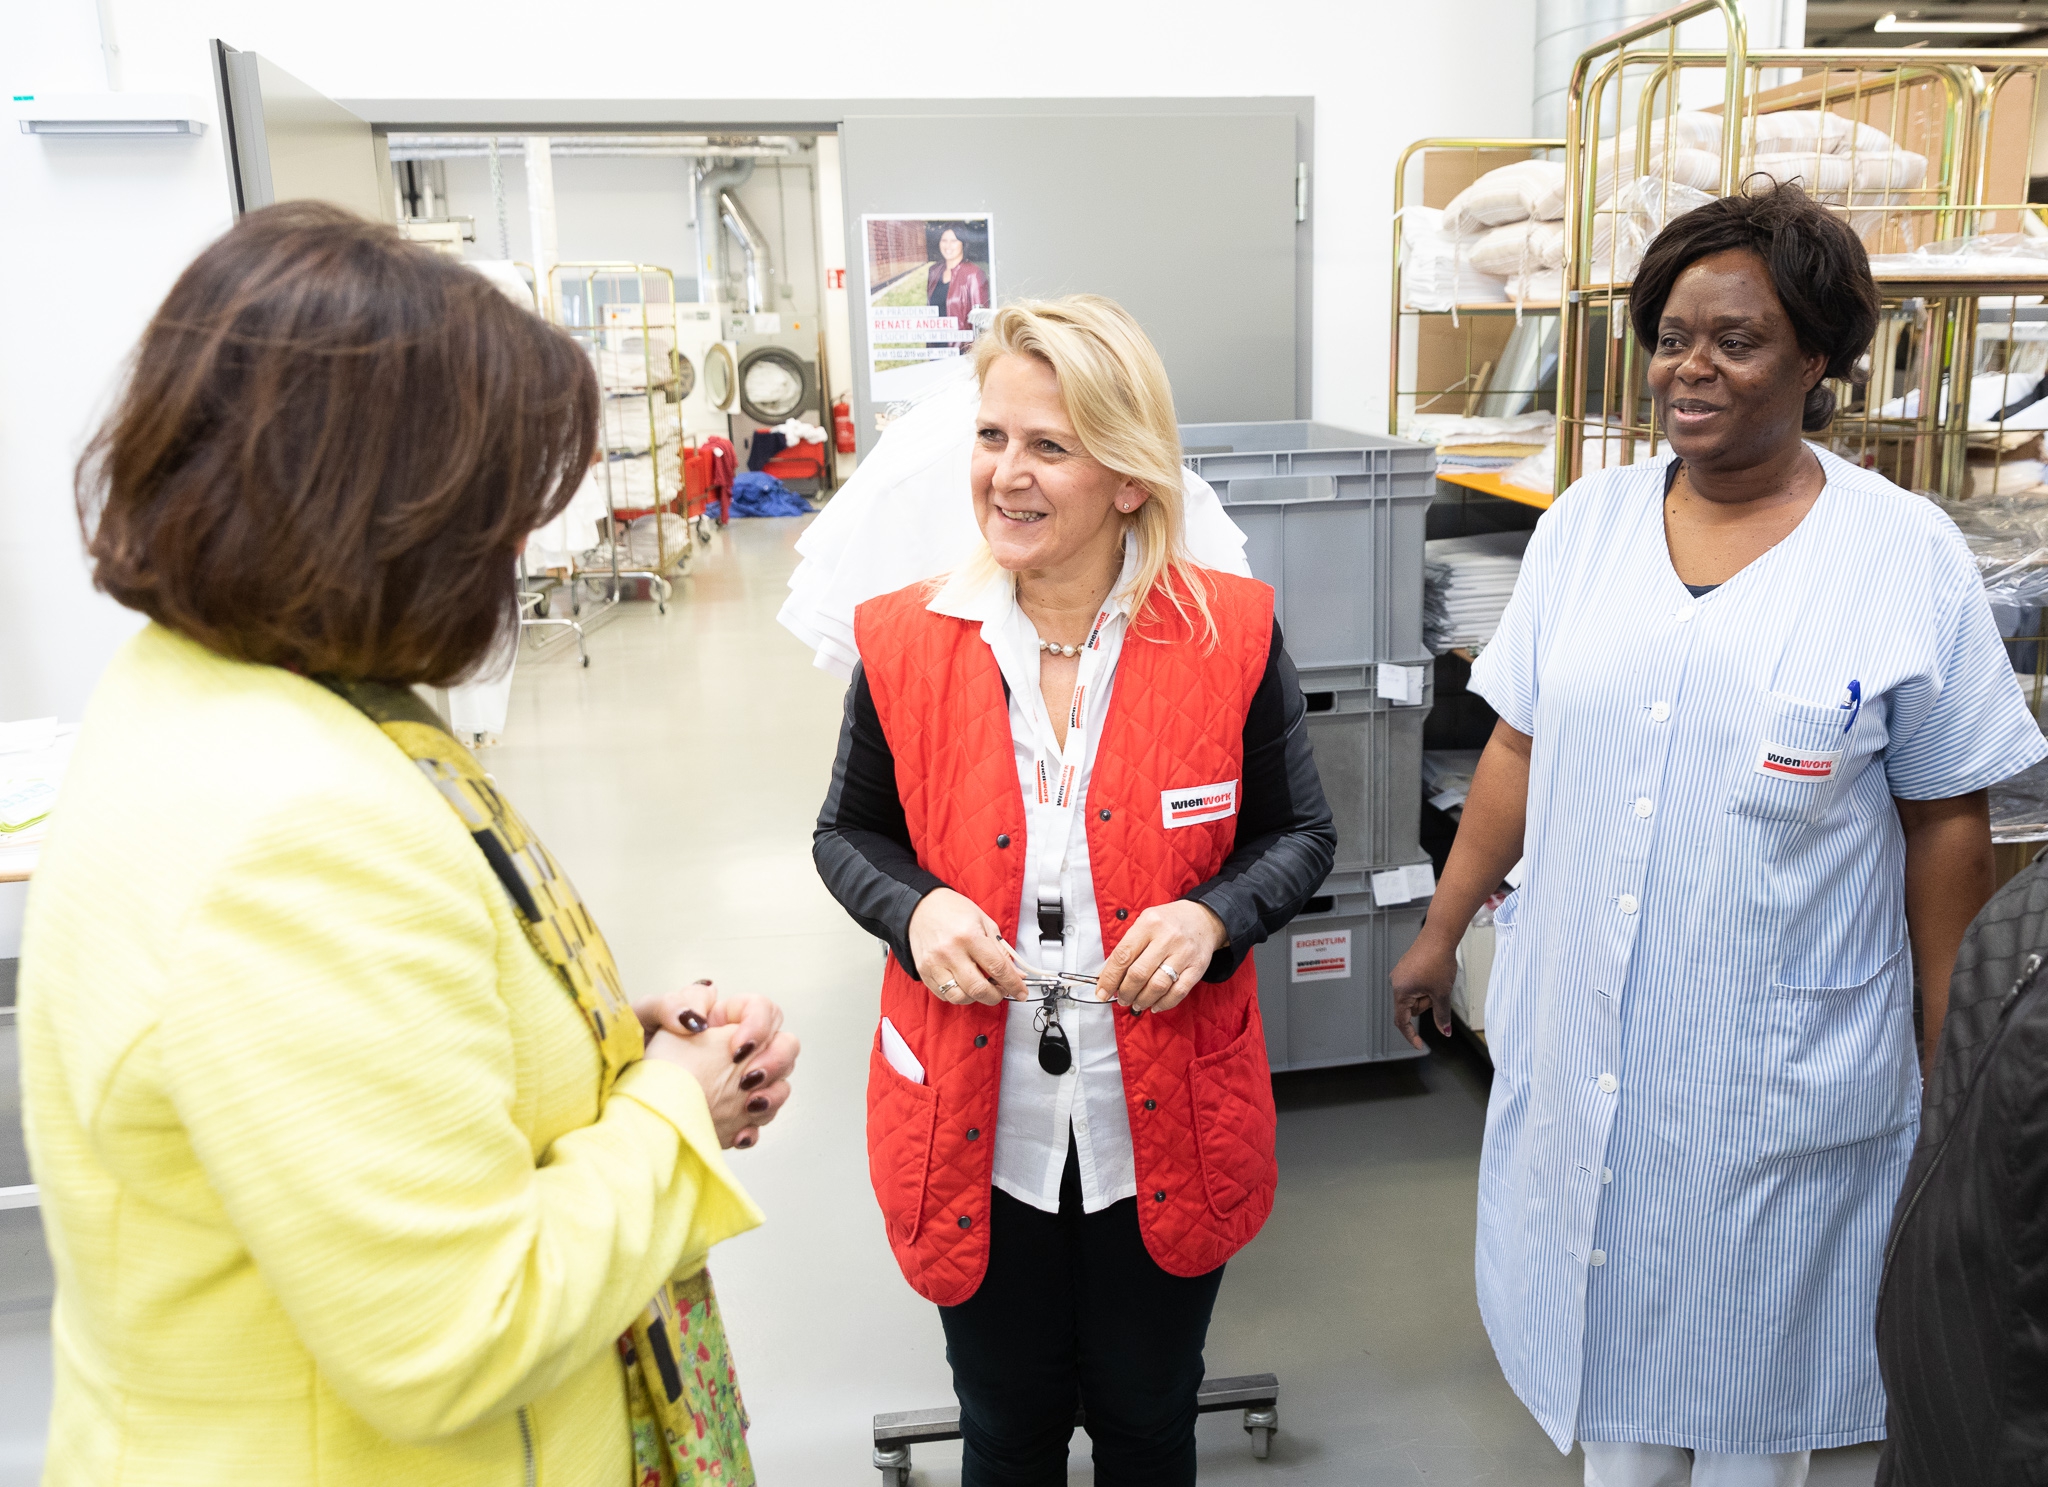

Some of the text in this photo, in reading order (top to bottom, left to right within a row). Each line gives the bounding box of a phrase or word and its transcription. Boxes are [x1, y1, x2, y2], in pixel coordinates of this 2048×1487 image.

[874, 318, 954, 330] RENATE ANDERL
[875, 332, 909, 341] BESUCHT
[940, 331, 971, 341] BETRIEB
[1088, 611, 1107, 648] wienwork
[1767, 752, 1833, 768] wienwork
[1171, 792, 1231, 809] wienwork
[1296, 936, 1347, 949] EIGENTUM
[1297, 957, 1346, 967] wienwork
